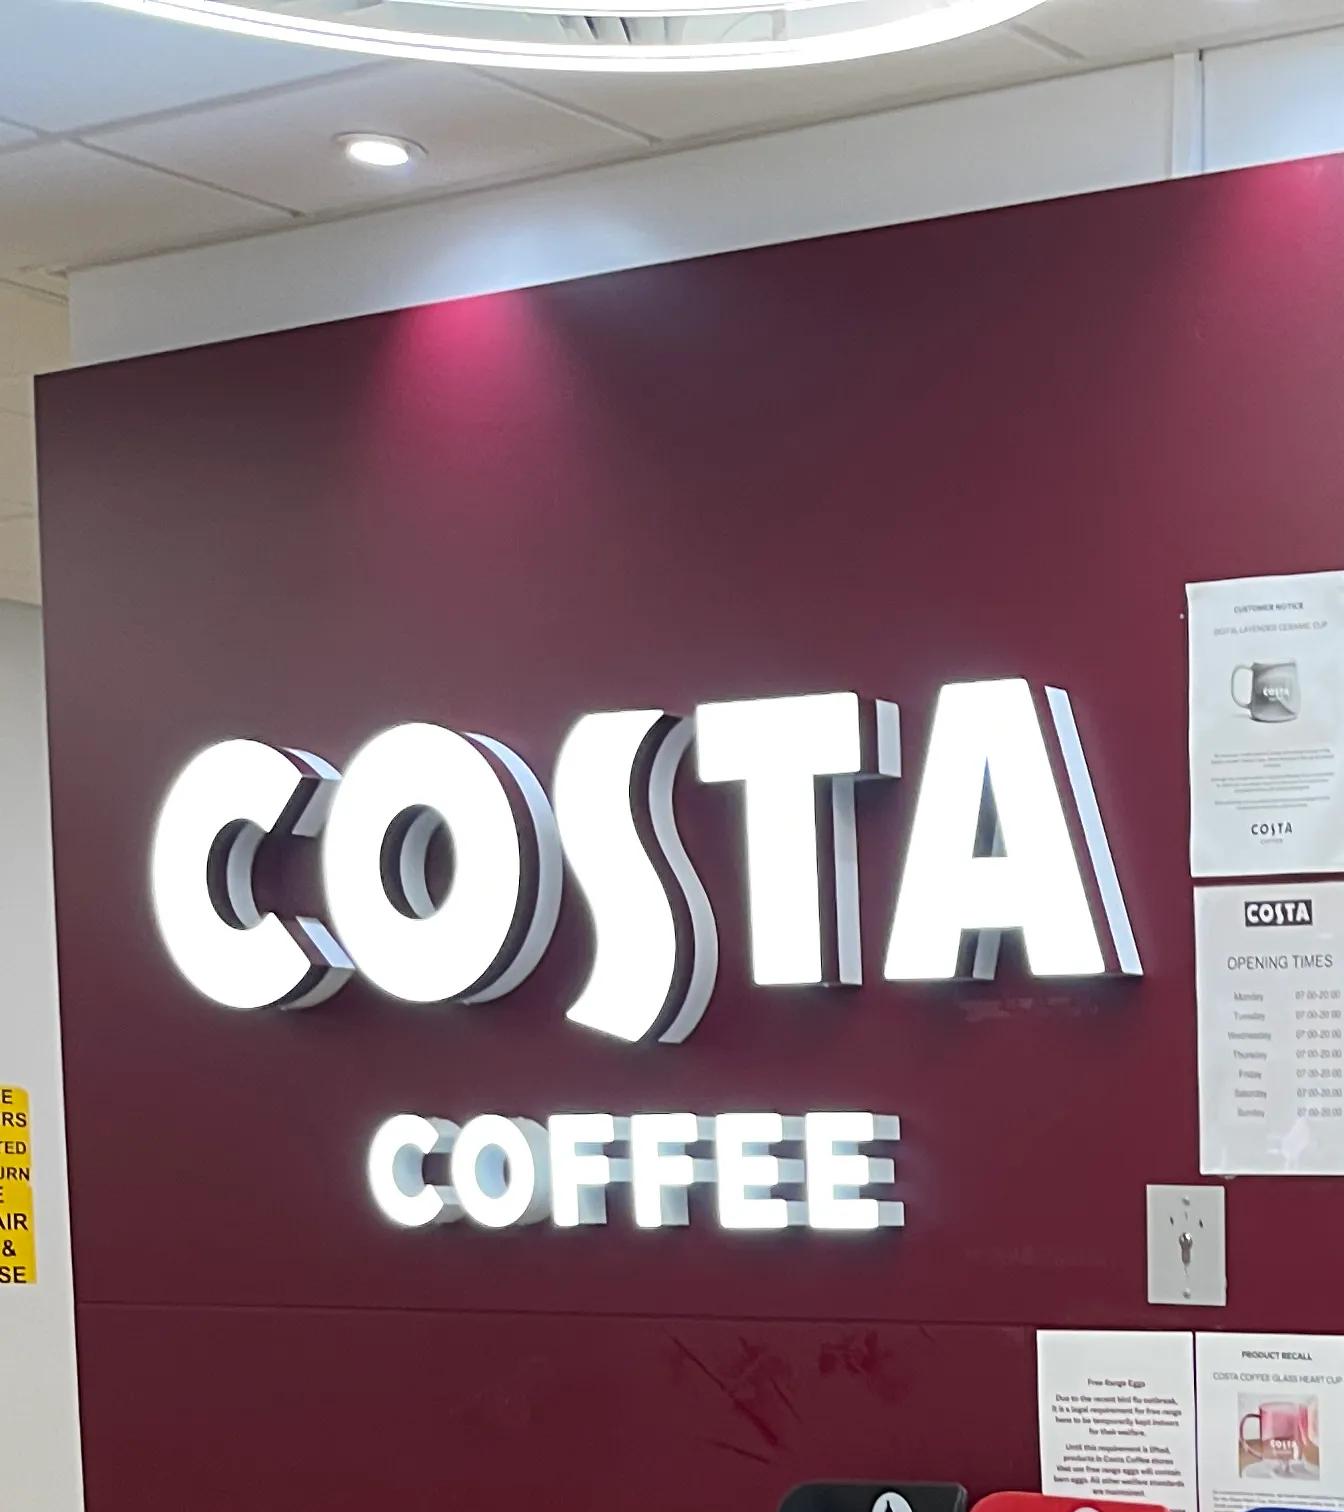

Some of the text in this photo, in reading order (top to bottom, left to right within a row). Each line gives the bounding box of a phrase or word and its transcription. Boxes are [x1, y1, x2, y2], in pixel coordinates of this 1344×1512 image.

[1251, 822, 1293, 836] COSTA
[152, 677, 1142, 1043] COSTA
[1246, 901, 1311, 925] COSTA
[1227, 954, 1333, 970] OPENING TIMES
[2, 1112, 27, 1128] RS
[0, 1141, 27, 1155] ED
[368, 1111, 904, 1229] COFFEE
[0, 1213, 29, 1231] IR
[1241, 1350, 1312, 1361] PRODUCT RECALL
[1212, 1372, 1239, 1381] COSTA
[1240, 1372, 1270, 1382] COFFEE
[1299, 1374, 1325, 1384] HEART
[1326, 1375, 1343, 1385] CUP
